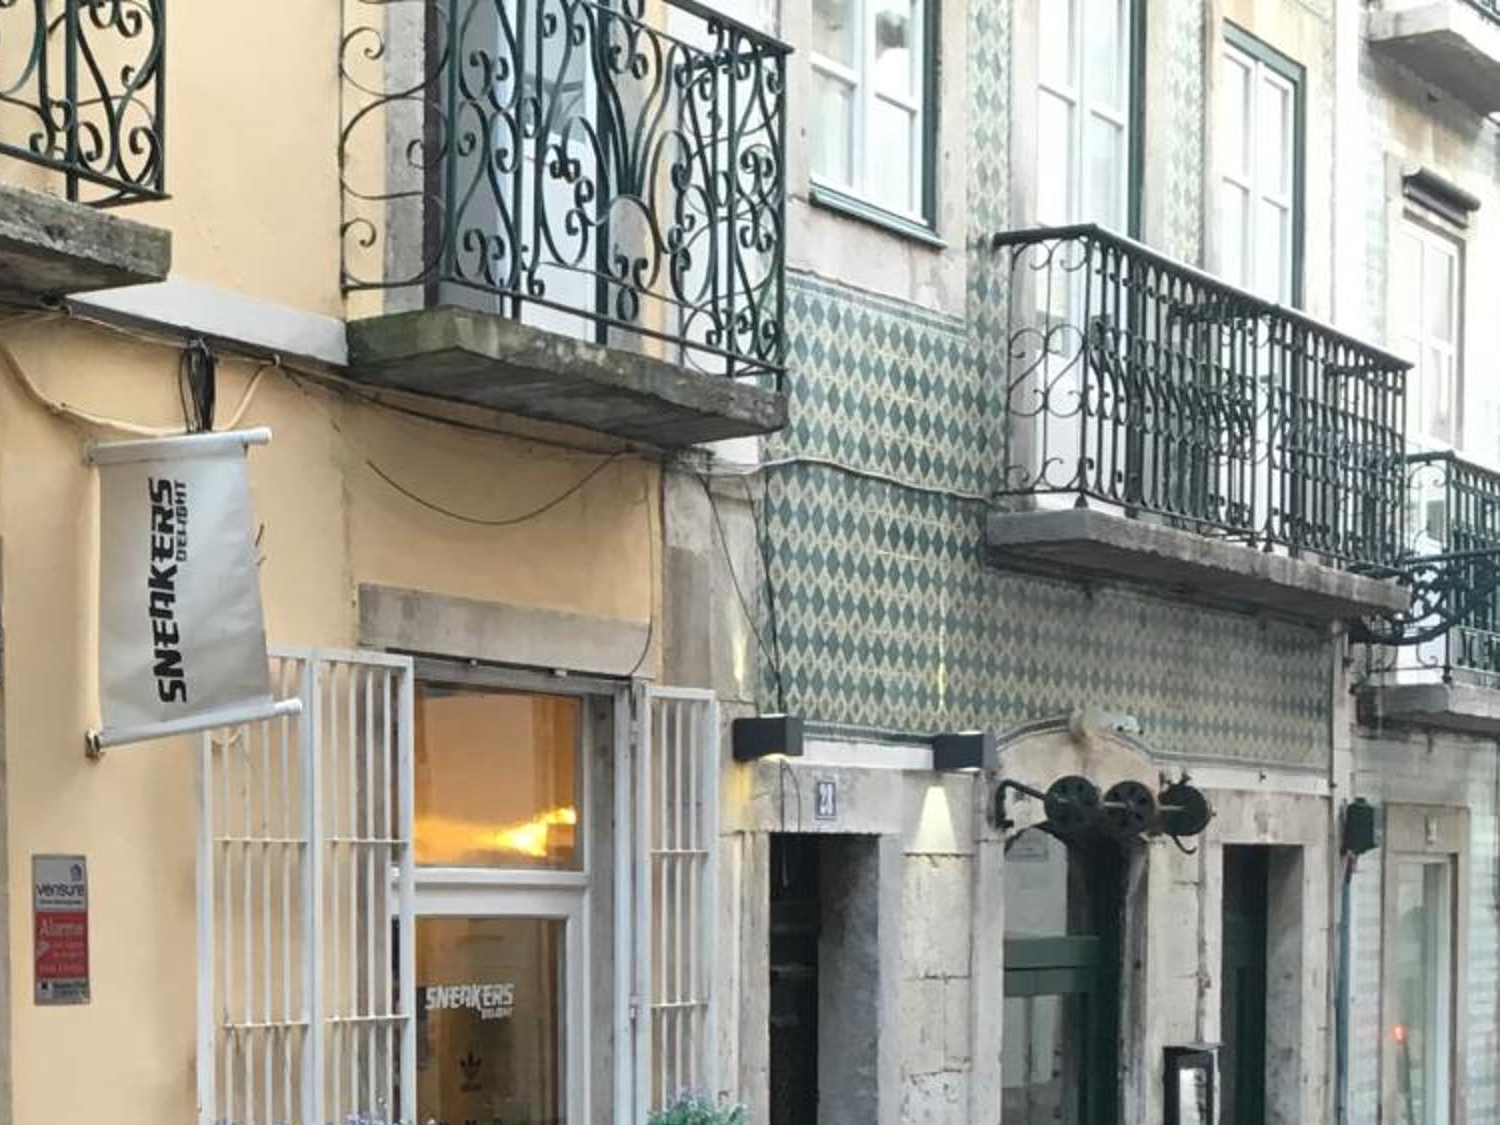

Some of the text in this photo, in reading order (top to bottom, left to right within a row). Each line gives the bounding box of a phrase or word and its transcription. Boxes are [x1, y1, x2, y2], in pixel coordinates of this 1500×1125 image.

[174, 479, 188, 562] DELIGHT
[148, 476, 188, 703] SNEAKERS
[425, 983, 515, 1011] SNEAKERS
